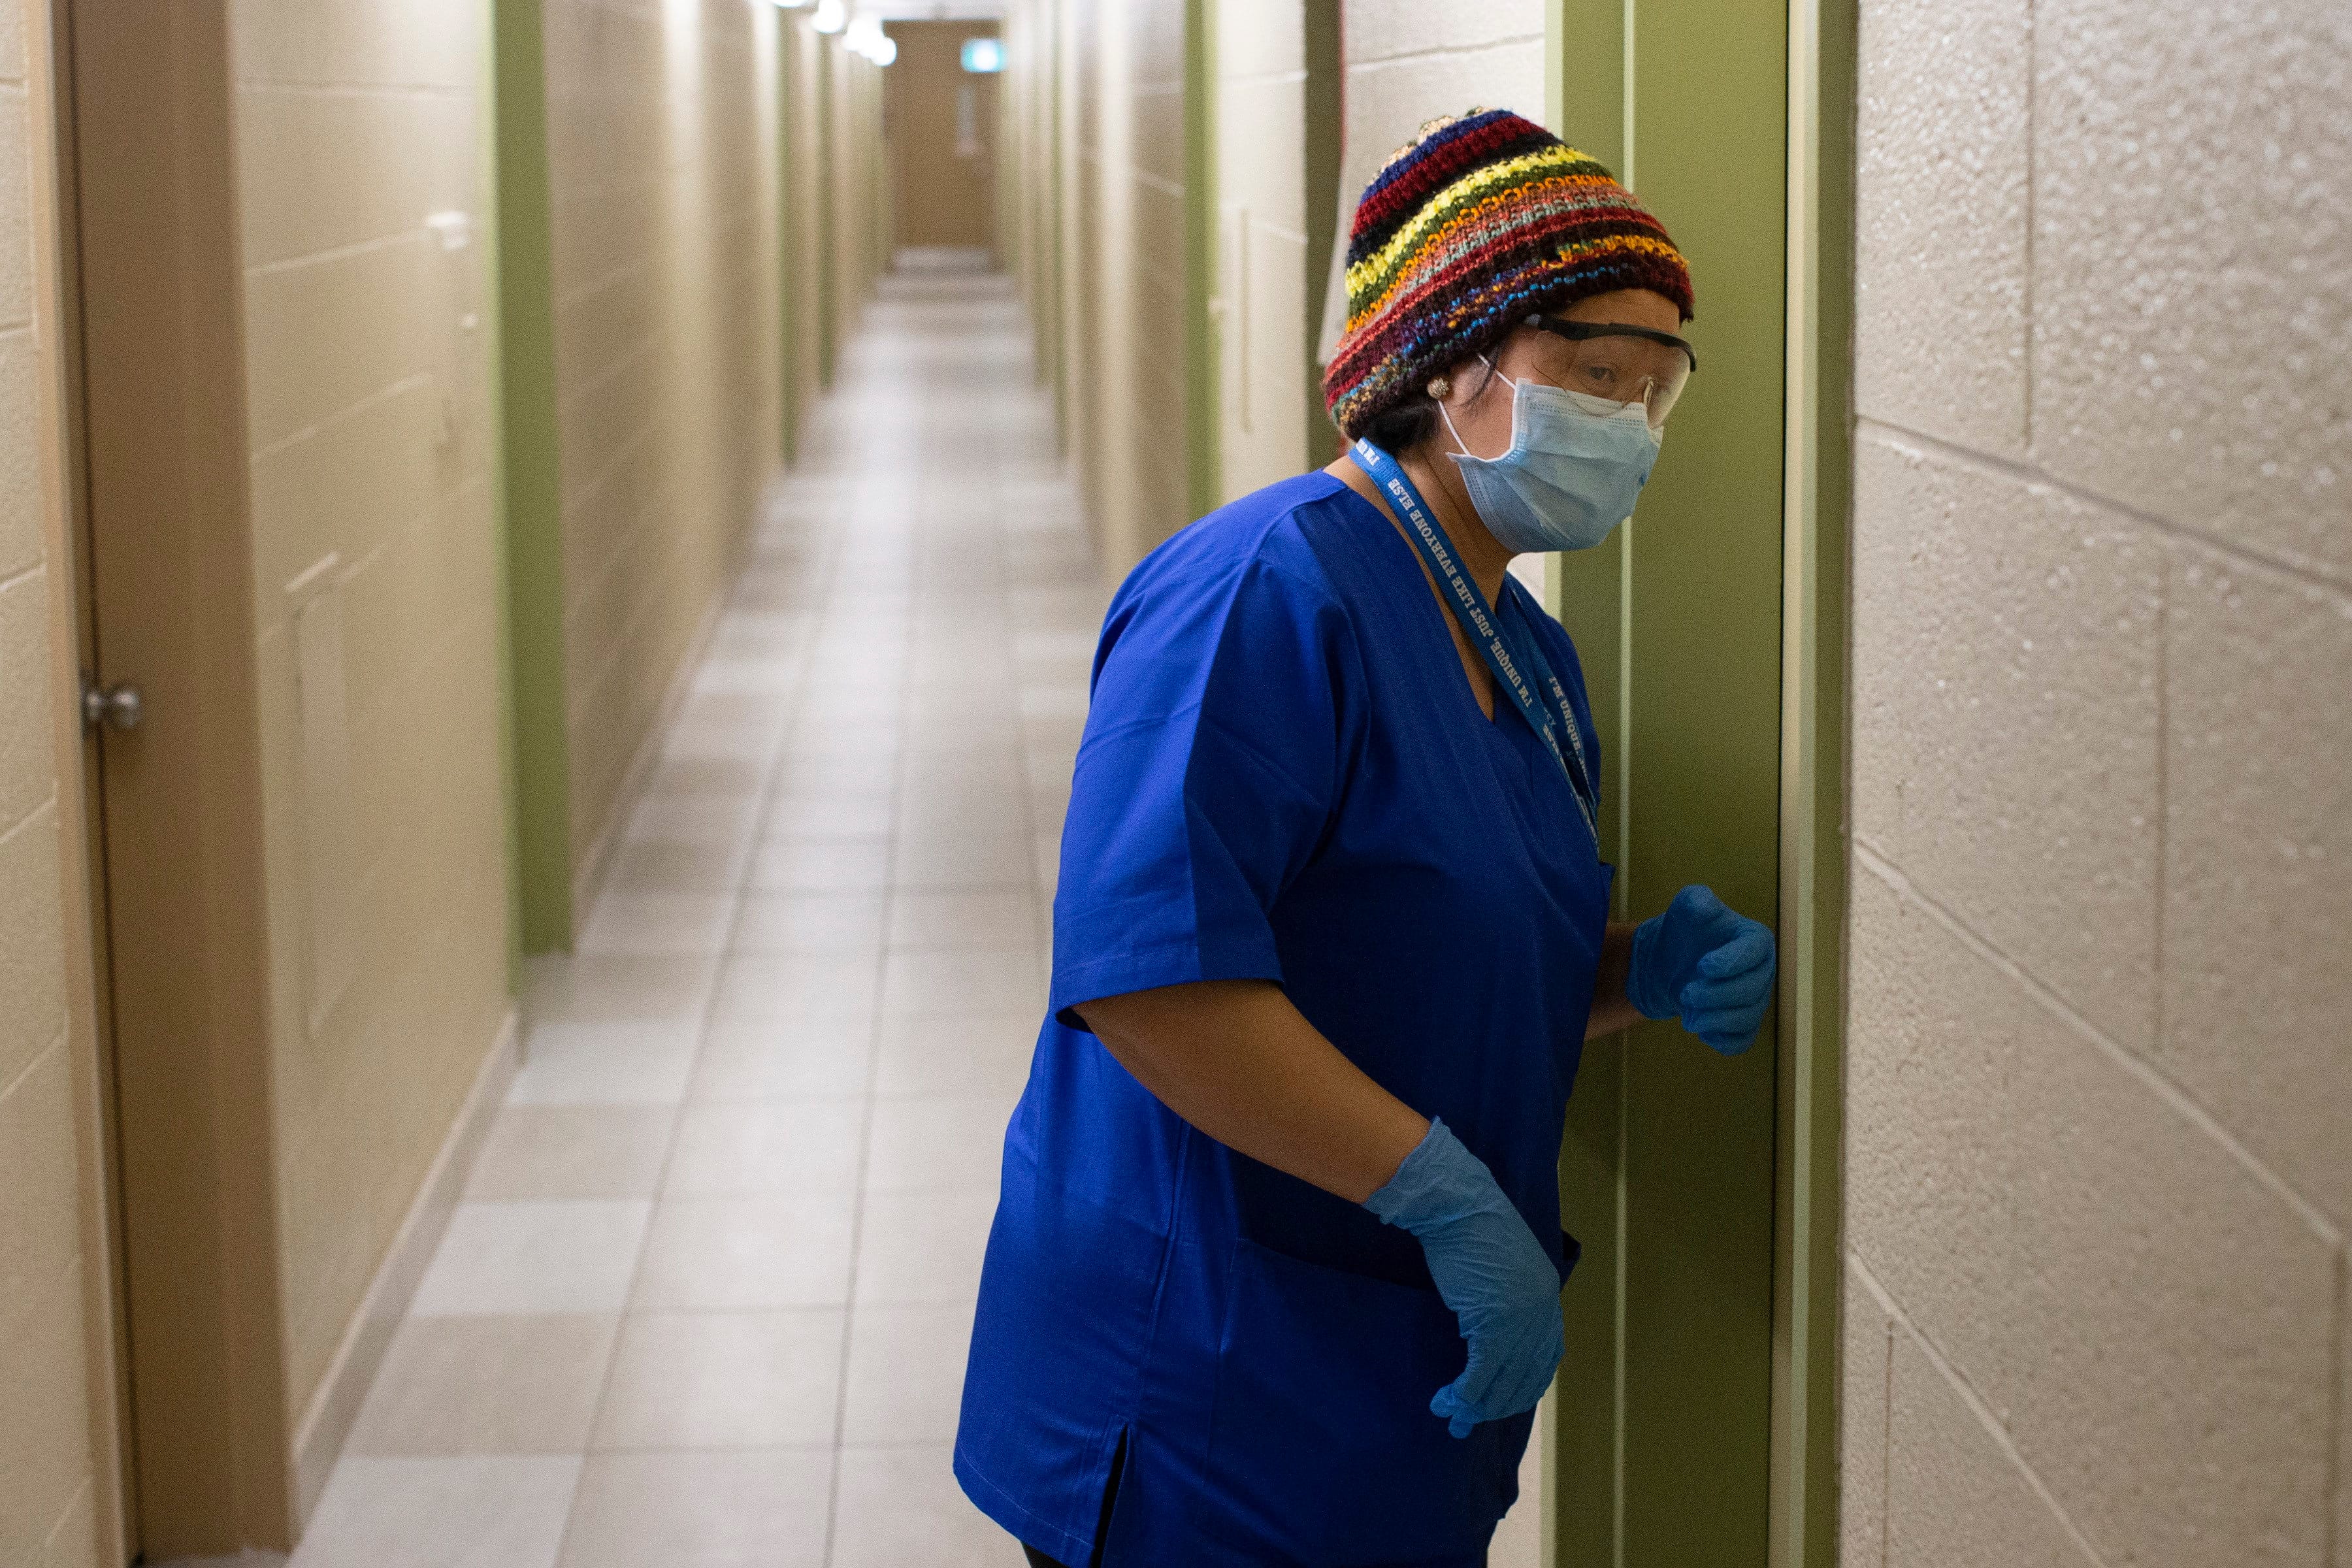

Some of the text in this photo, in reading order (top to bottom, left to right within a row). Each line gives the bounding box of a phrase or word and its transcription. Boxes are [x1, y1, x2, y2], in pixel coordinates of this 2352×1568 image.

[1388, 478, 1533, 708] I'M UNIQUE, JUST LIKE EVERYONE ELSE
[1549, 676, 1563, 698] I'M
